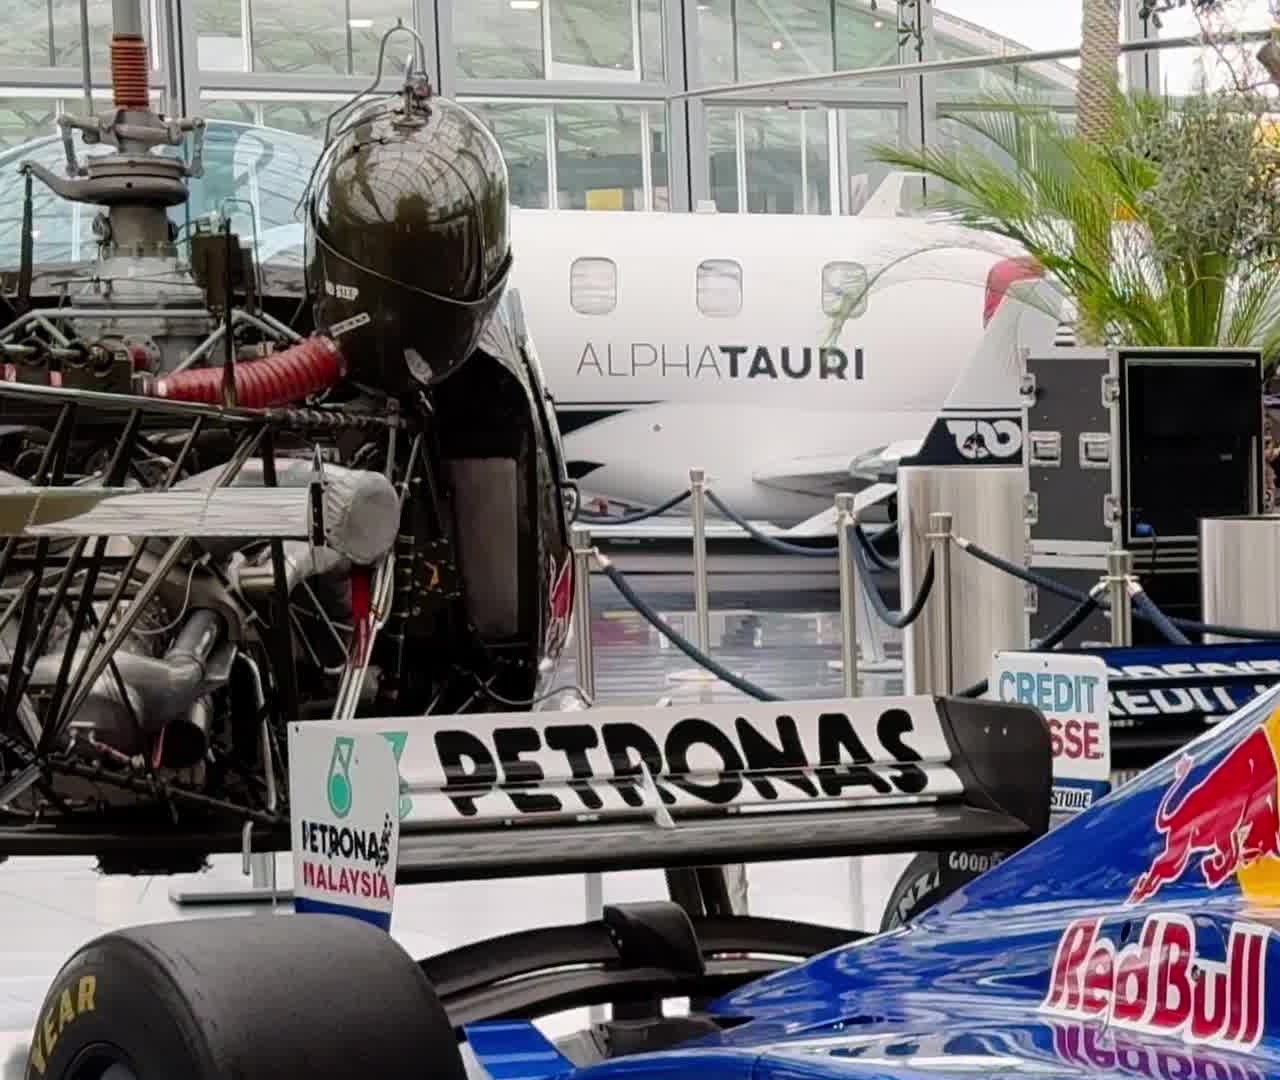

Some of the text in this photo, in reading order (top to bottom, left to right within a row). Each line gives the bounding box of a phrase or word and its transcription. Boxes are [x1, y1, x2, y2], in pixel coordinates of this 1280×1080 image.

[576, 342, 865, 380] ALPHATAURI
[999, 670, 1100, 714] CREDIT
[434, 708, 931, 817] PETRONAS
[303, 861, 391, 901] MALAYSIA
[1045, 911, 1273, 1053] Red Bull
